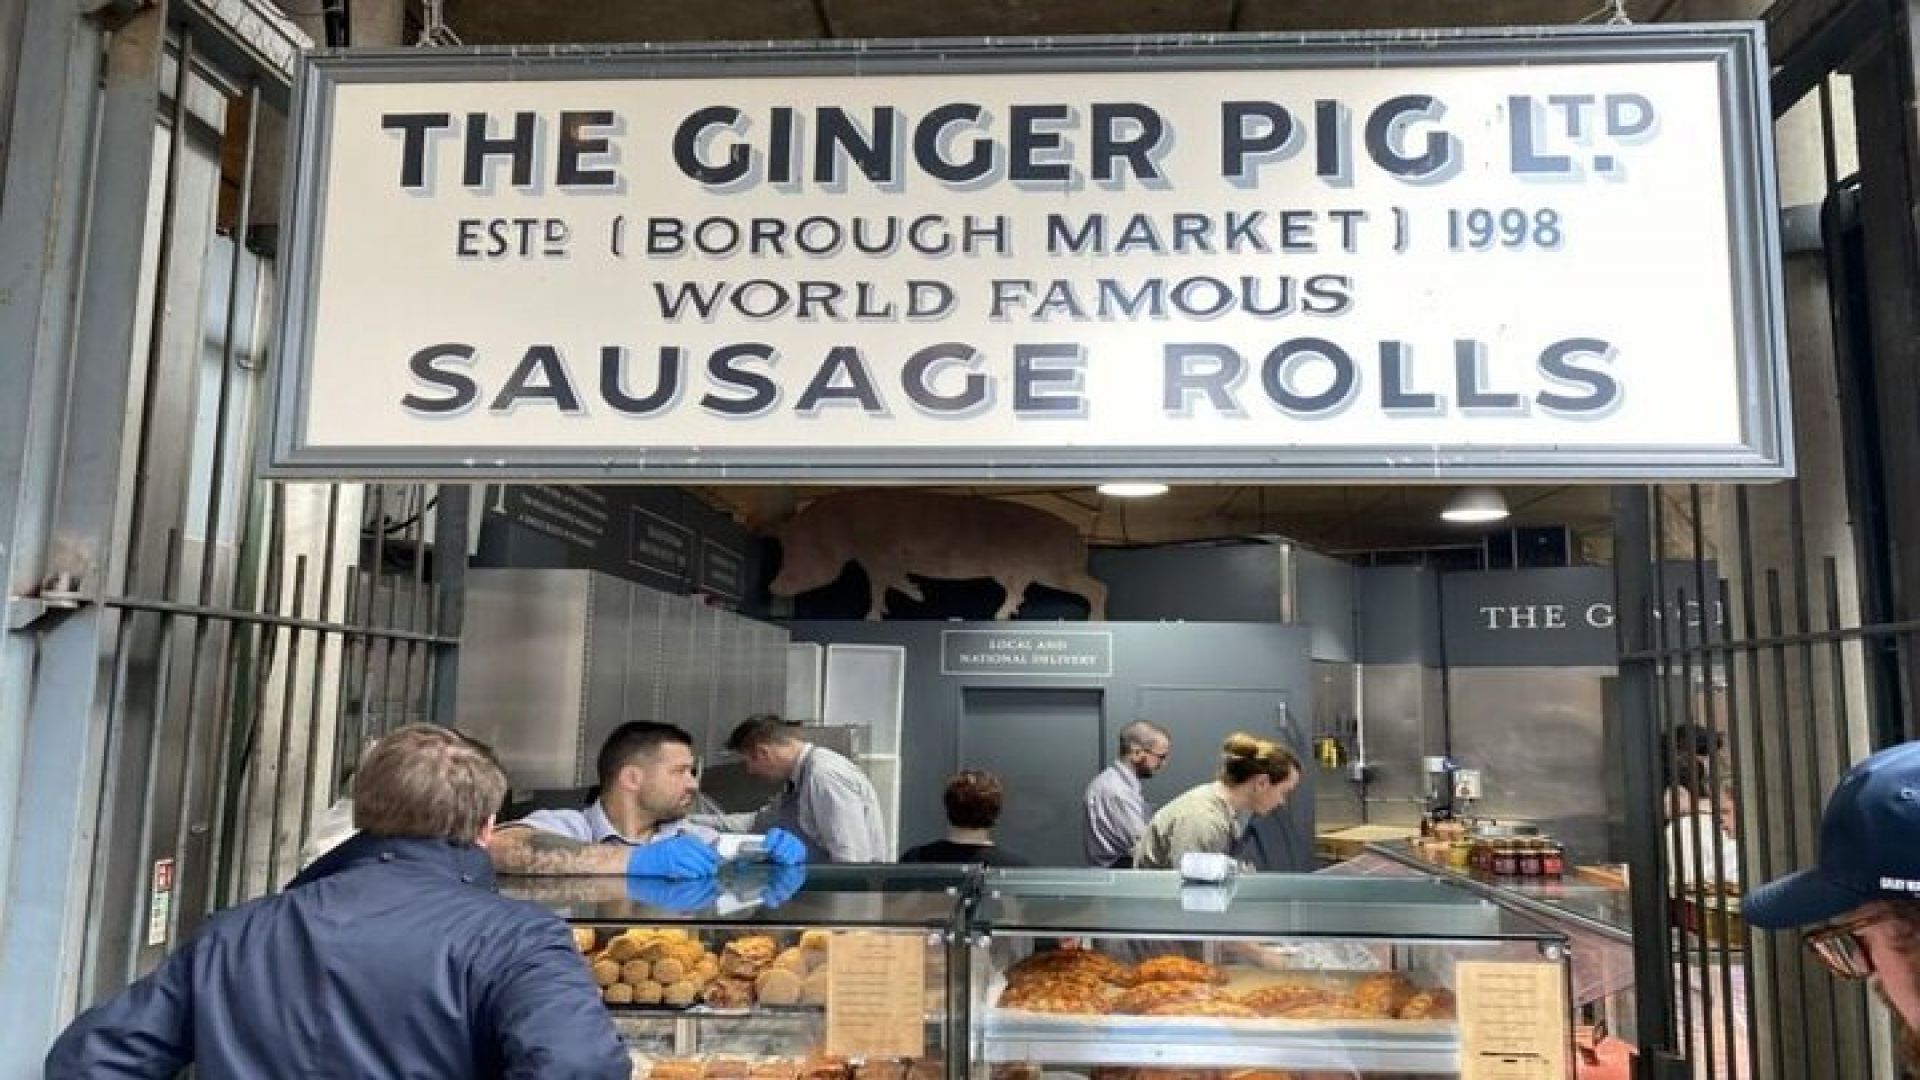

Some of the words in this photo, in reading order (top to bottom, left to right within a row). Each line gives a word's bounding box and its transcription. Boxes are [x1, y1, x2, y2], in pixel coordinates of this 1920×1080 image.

[381, 109, 623, 195] THE
[672, 102, 1172, 193] GINGER
[1220, 93, 1462, 190] PIG
[456, 216, 570, 258] ESTD
[1447, 207, 1562, 252] 1998
[652, 278, 958, 323] WORLD
[989, 274, 1353, 322] FAMOUS
[400, 341, 1087, 418] SAUSAGE
[1162, 335, 1624, 420] ROLLS
[1479, 603, 1567, 629] THE
[959, 653, 1028, 665] NATIONAL
[1031, 654, 1098, 666] DELIVERY
[988, 638, 1032, 650] LOCAL
[1036, 638, 1068, 651] AND
